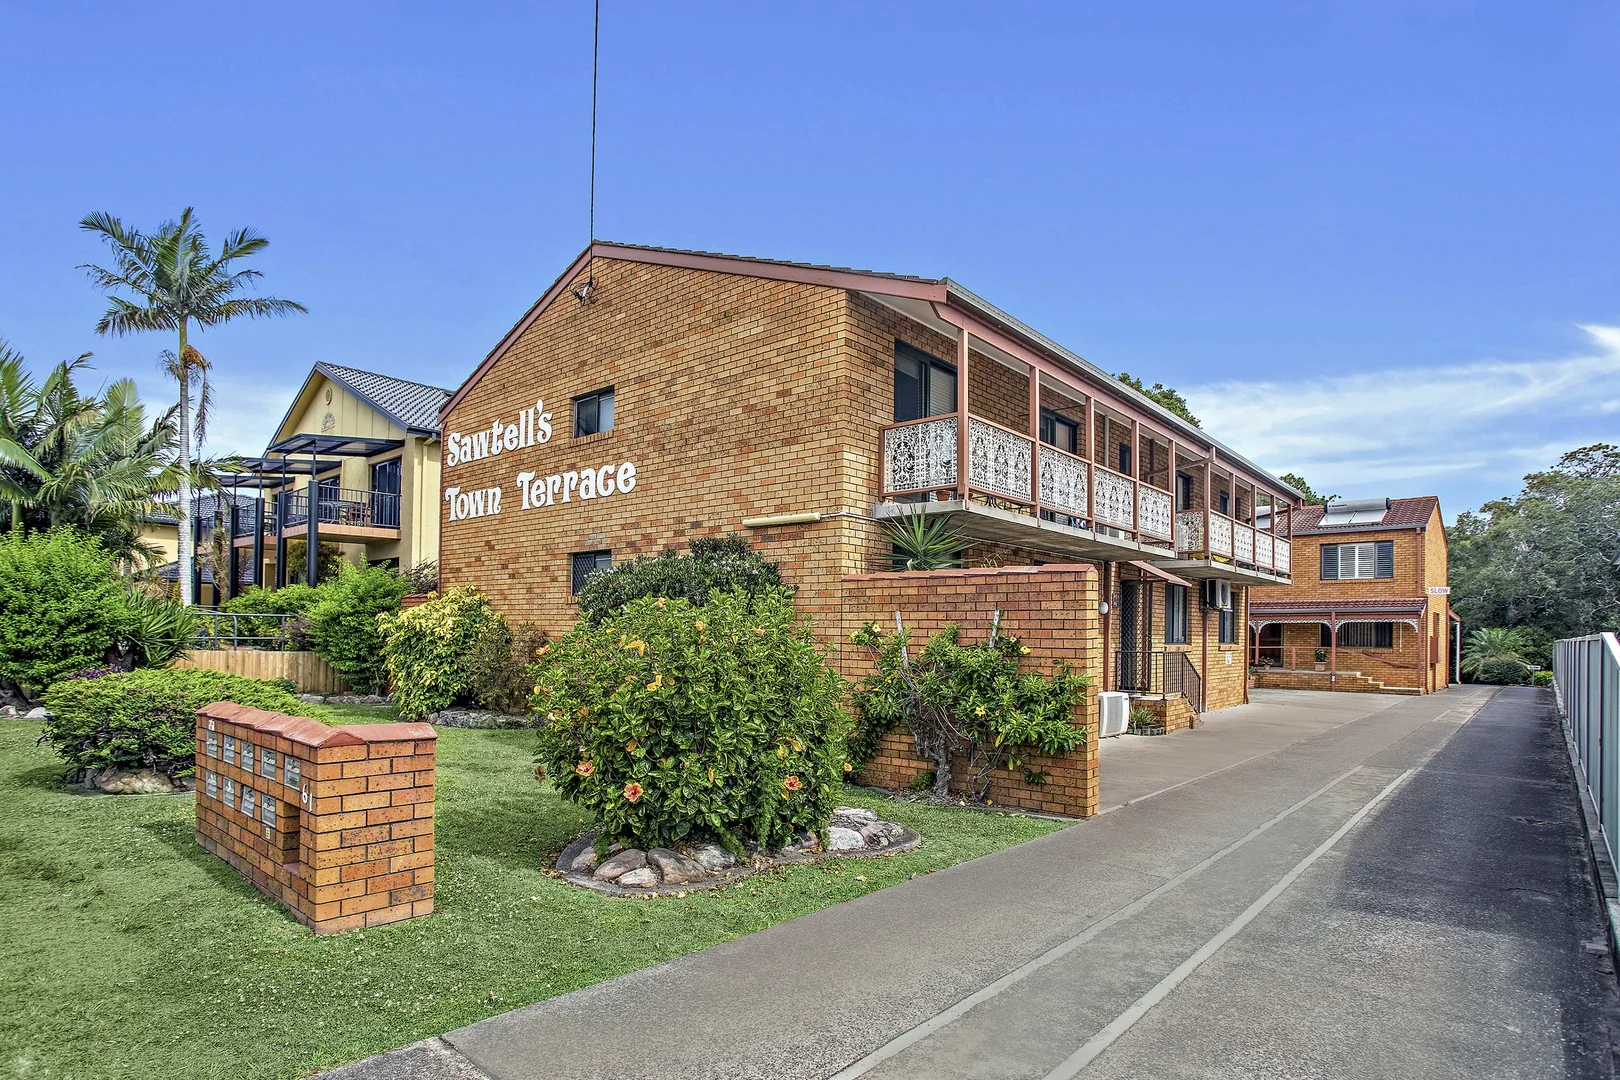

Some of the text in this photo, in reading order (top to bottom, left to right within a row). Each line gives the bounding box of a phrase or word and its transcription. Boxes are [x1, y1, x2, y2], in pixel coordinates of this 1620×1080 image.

[447, 399, 553, 467] Sawtell's
[445, 461, 637, 522] Town Terrace
[302, 783, 313, 813] 61
